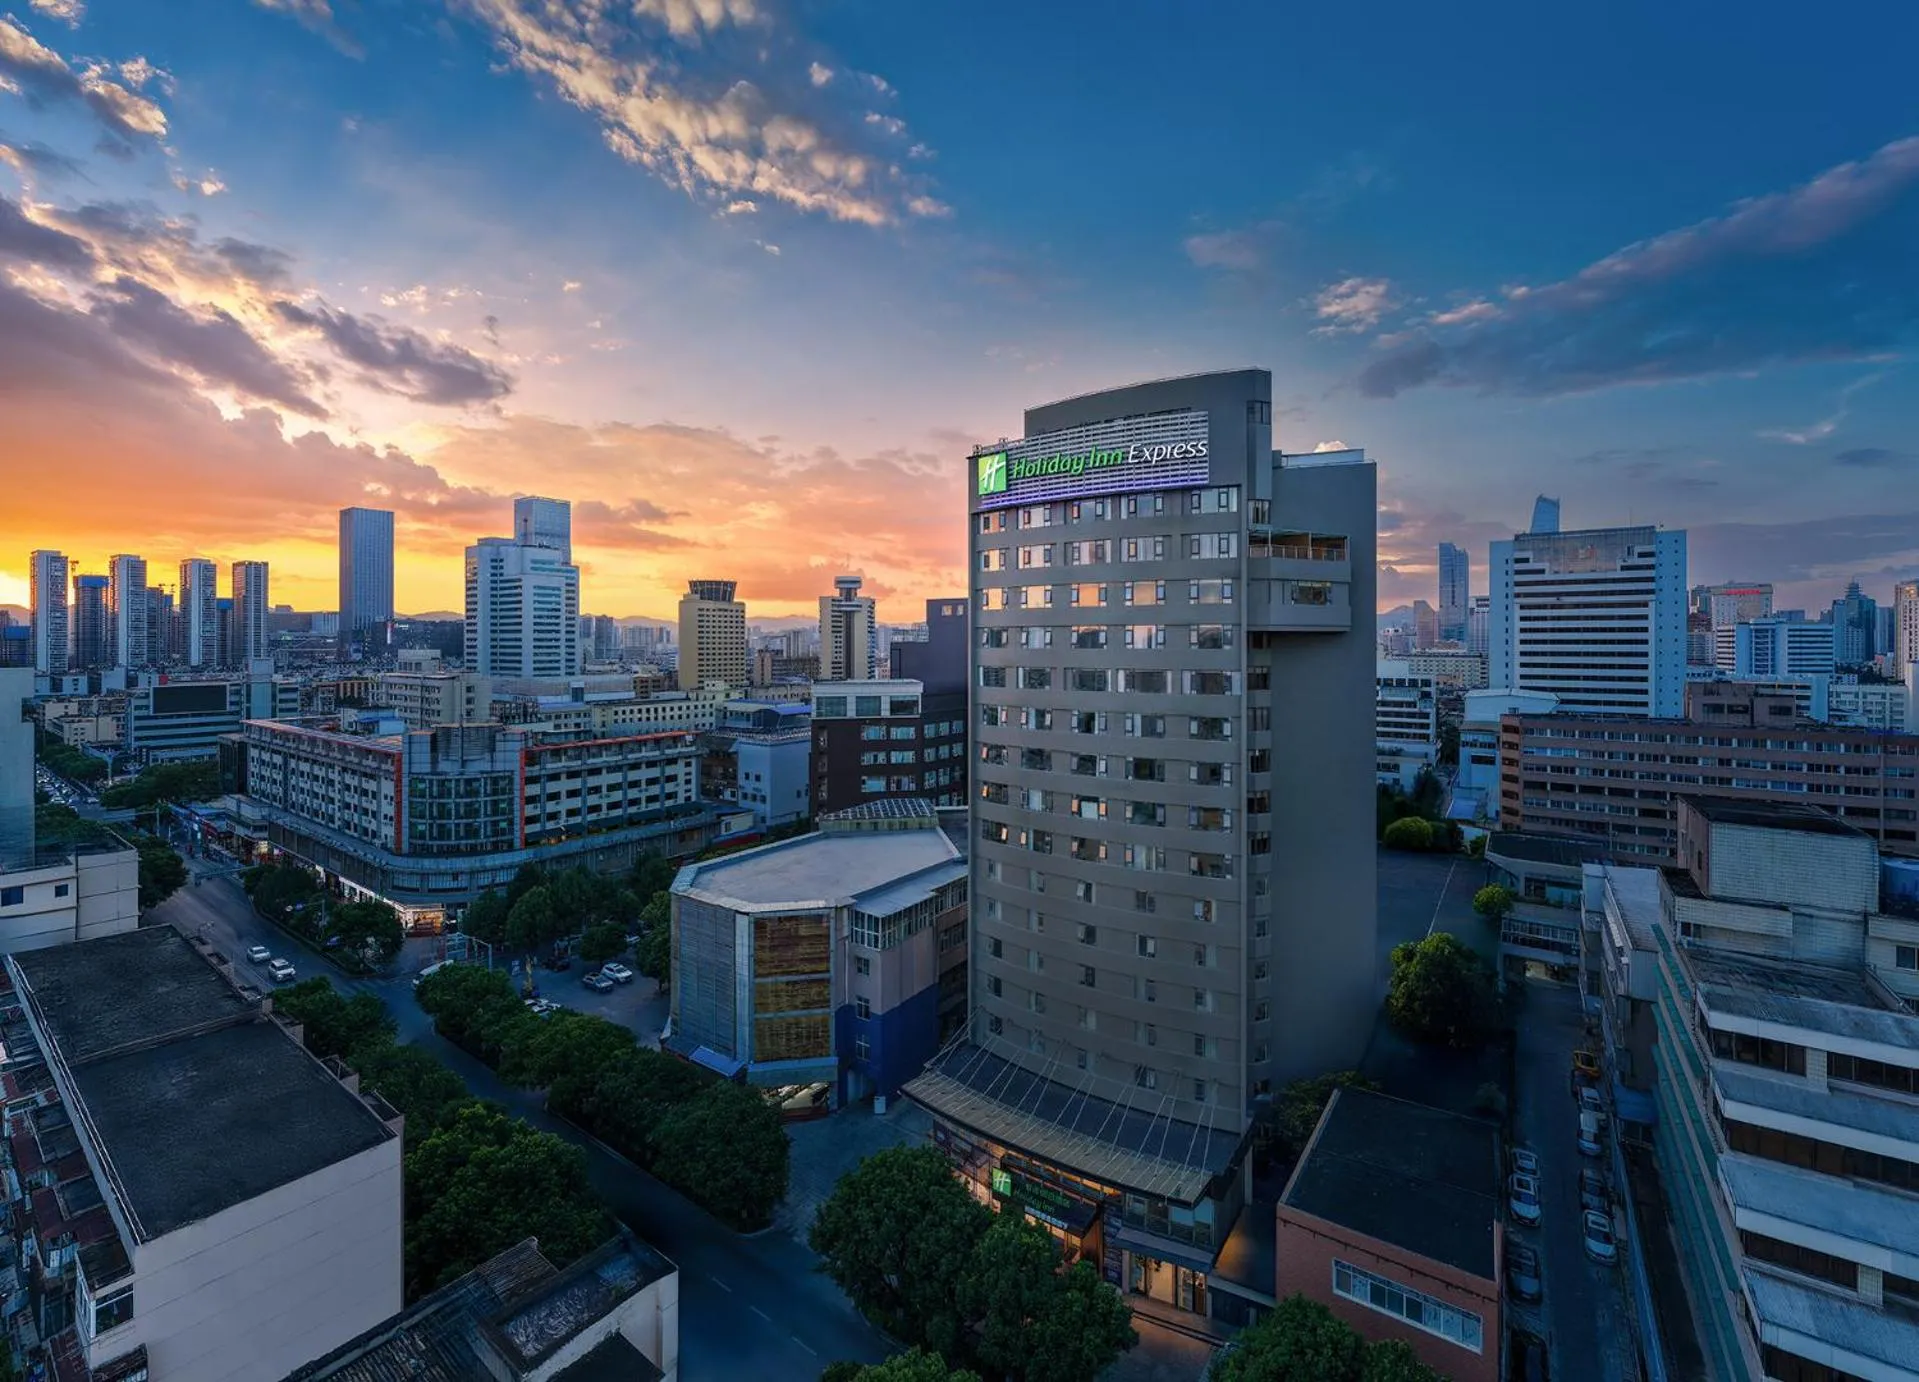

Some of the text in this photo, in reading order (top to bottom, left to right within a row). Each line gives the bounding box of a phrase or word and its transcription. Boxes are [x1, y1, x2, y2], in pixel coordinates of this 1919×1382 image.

[1013, 440, 1208, 479] Holiday Inn Express
